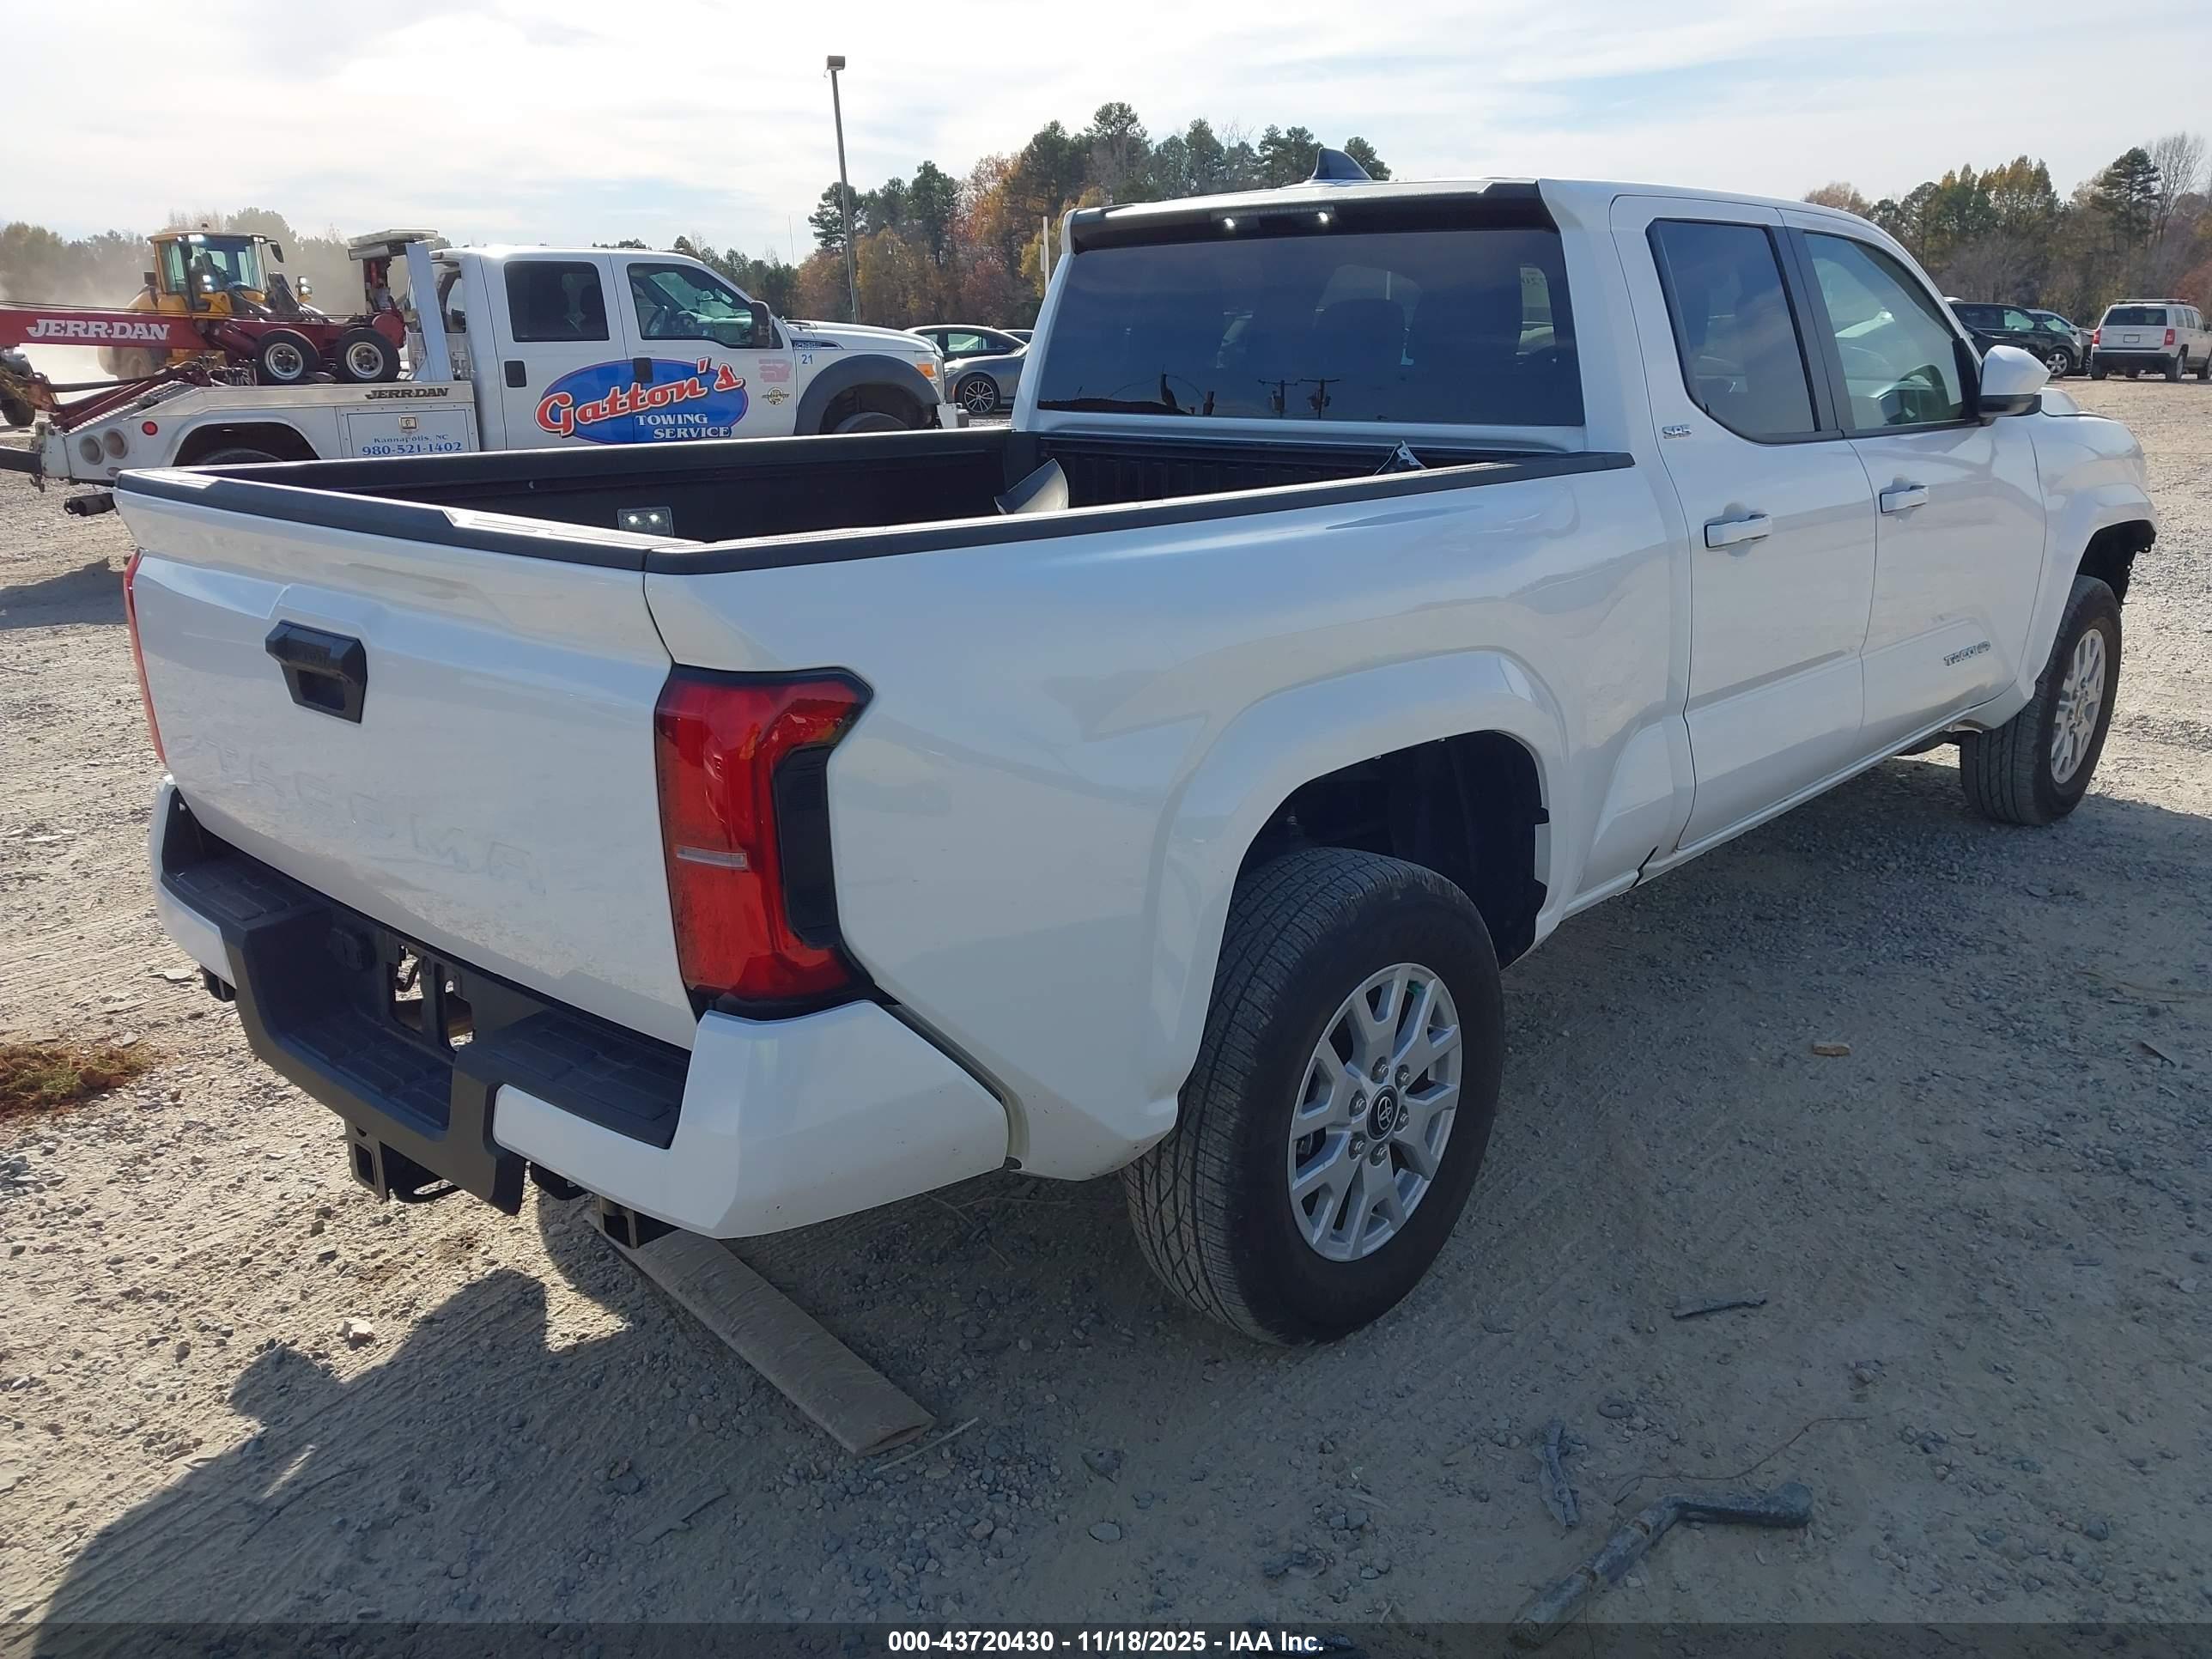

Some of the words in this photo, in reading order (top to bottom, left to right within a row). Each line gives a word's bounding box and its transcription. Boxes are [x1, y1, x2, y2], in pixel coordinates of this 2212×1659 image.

[26, 319, 171, 341] JERR-DAN
[801, 354, 813, 365] 21
[365, 387, 450, 400] JERR-DAN
[533, 357, 746, 439] Gatton's
[635, 413, 708, 426] TOWING
[653, 426, 730, 440] SERVICE
[362, 441, 462, 456] 980-521-1402
